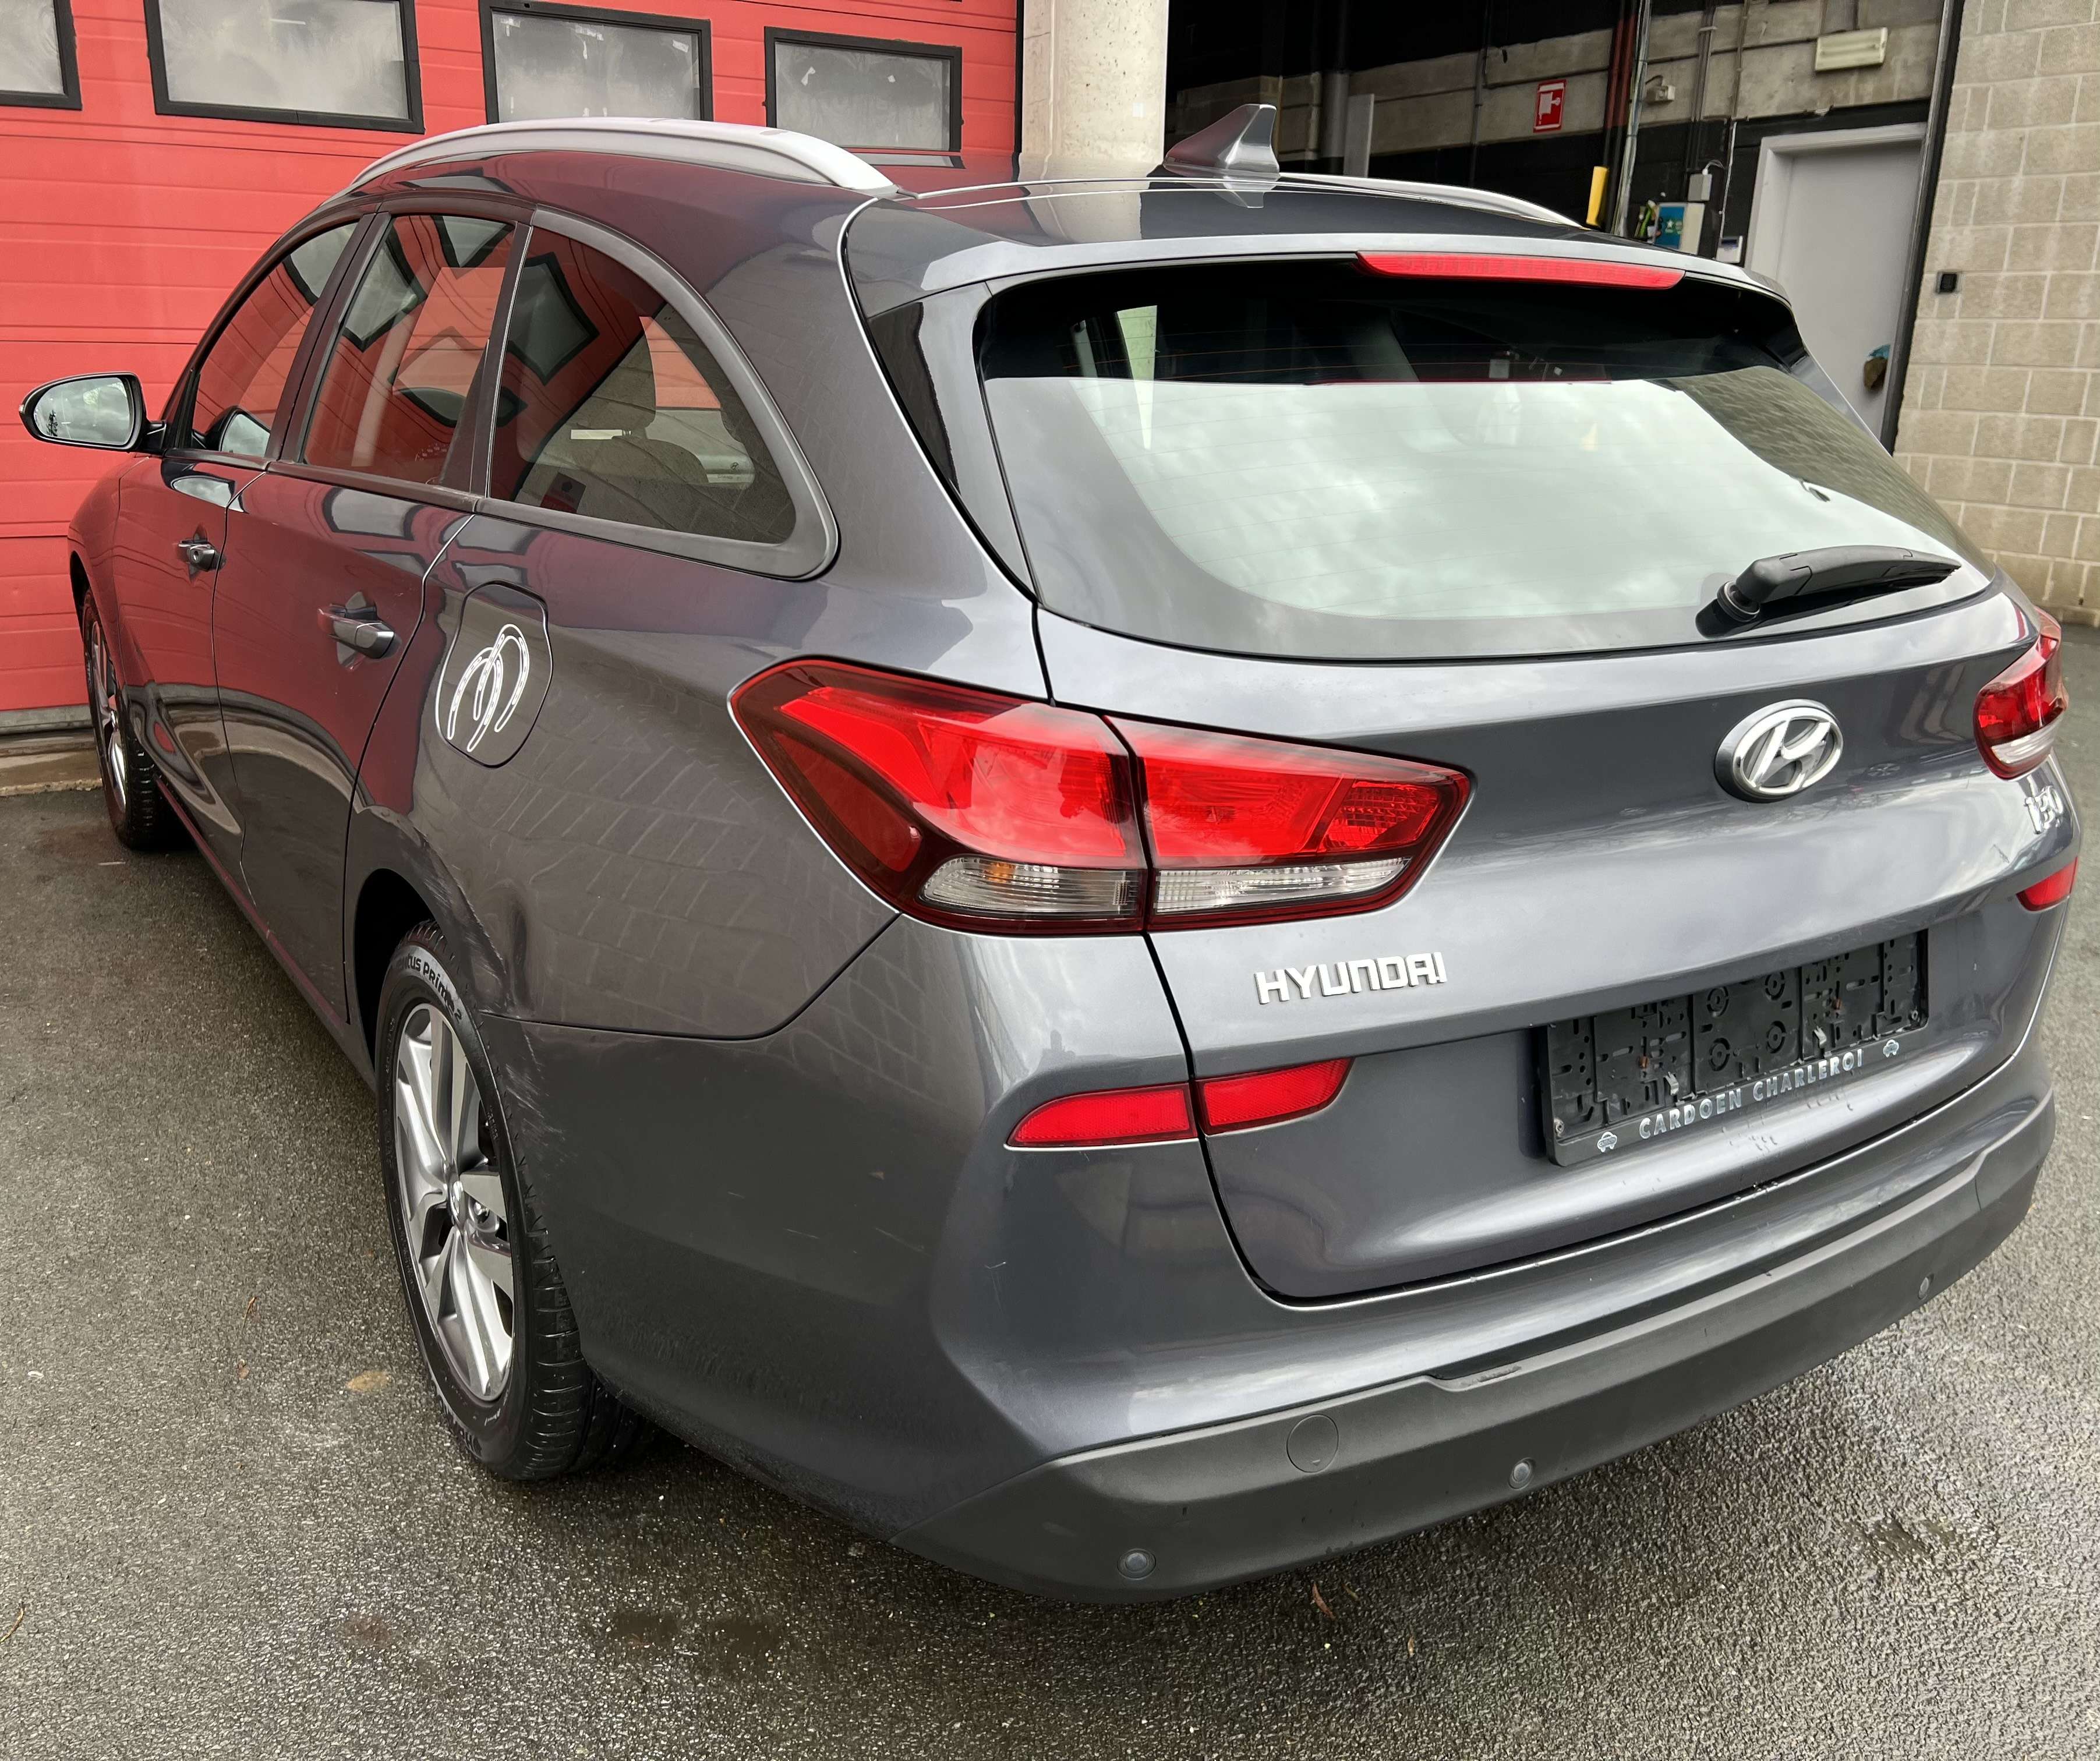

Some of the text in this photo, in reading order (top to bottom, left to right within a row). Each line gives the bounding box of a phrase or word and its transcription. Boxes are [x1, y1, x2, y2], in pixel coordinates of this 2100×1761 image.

[1254, 952, 1448, 1005] HYUNDAI
[1639, 1048, 1864, 1134] CARDOEN CHARLEROI
